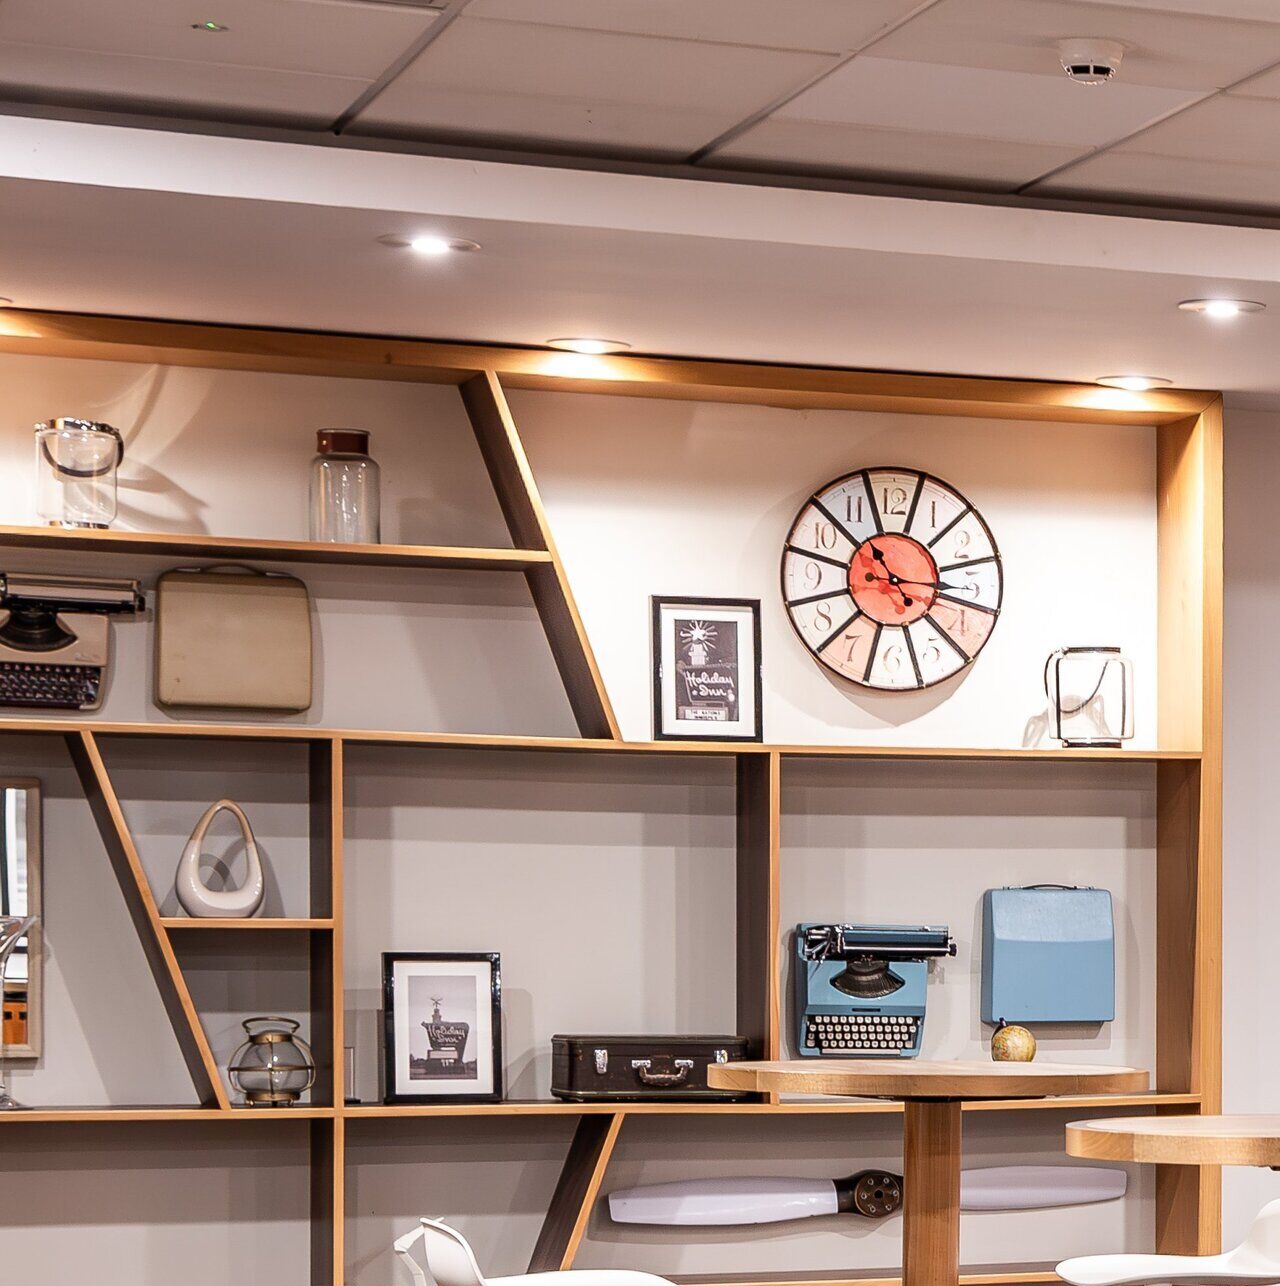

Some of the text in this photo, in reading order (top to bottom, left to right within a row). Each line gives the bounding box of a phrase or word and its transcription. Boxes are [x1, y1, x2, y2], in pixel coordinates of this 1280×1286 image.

[846, 496, 863, 523] 11
[882, 487, 907, 516] 12
[930, 501, 936, 528] 1
[814, 521, 838, 550] 10
[954, 530, 971, 559] 2
[804, 561, 823, 591] 9
[813, 601, 833, 632] 8
[947, 609, 970, 637] 4
[845, 634, 863, 662] 7
[883, 645, 903, 673] 6
[922, 636, 941, 664] 5
[687, 671, 735, 688] Holiday
[699, 684, 727, 697] Inn
[428, 1025, 466, 1038] Holiday
